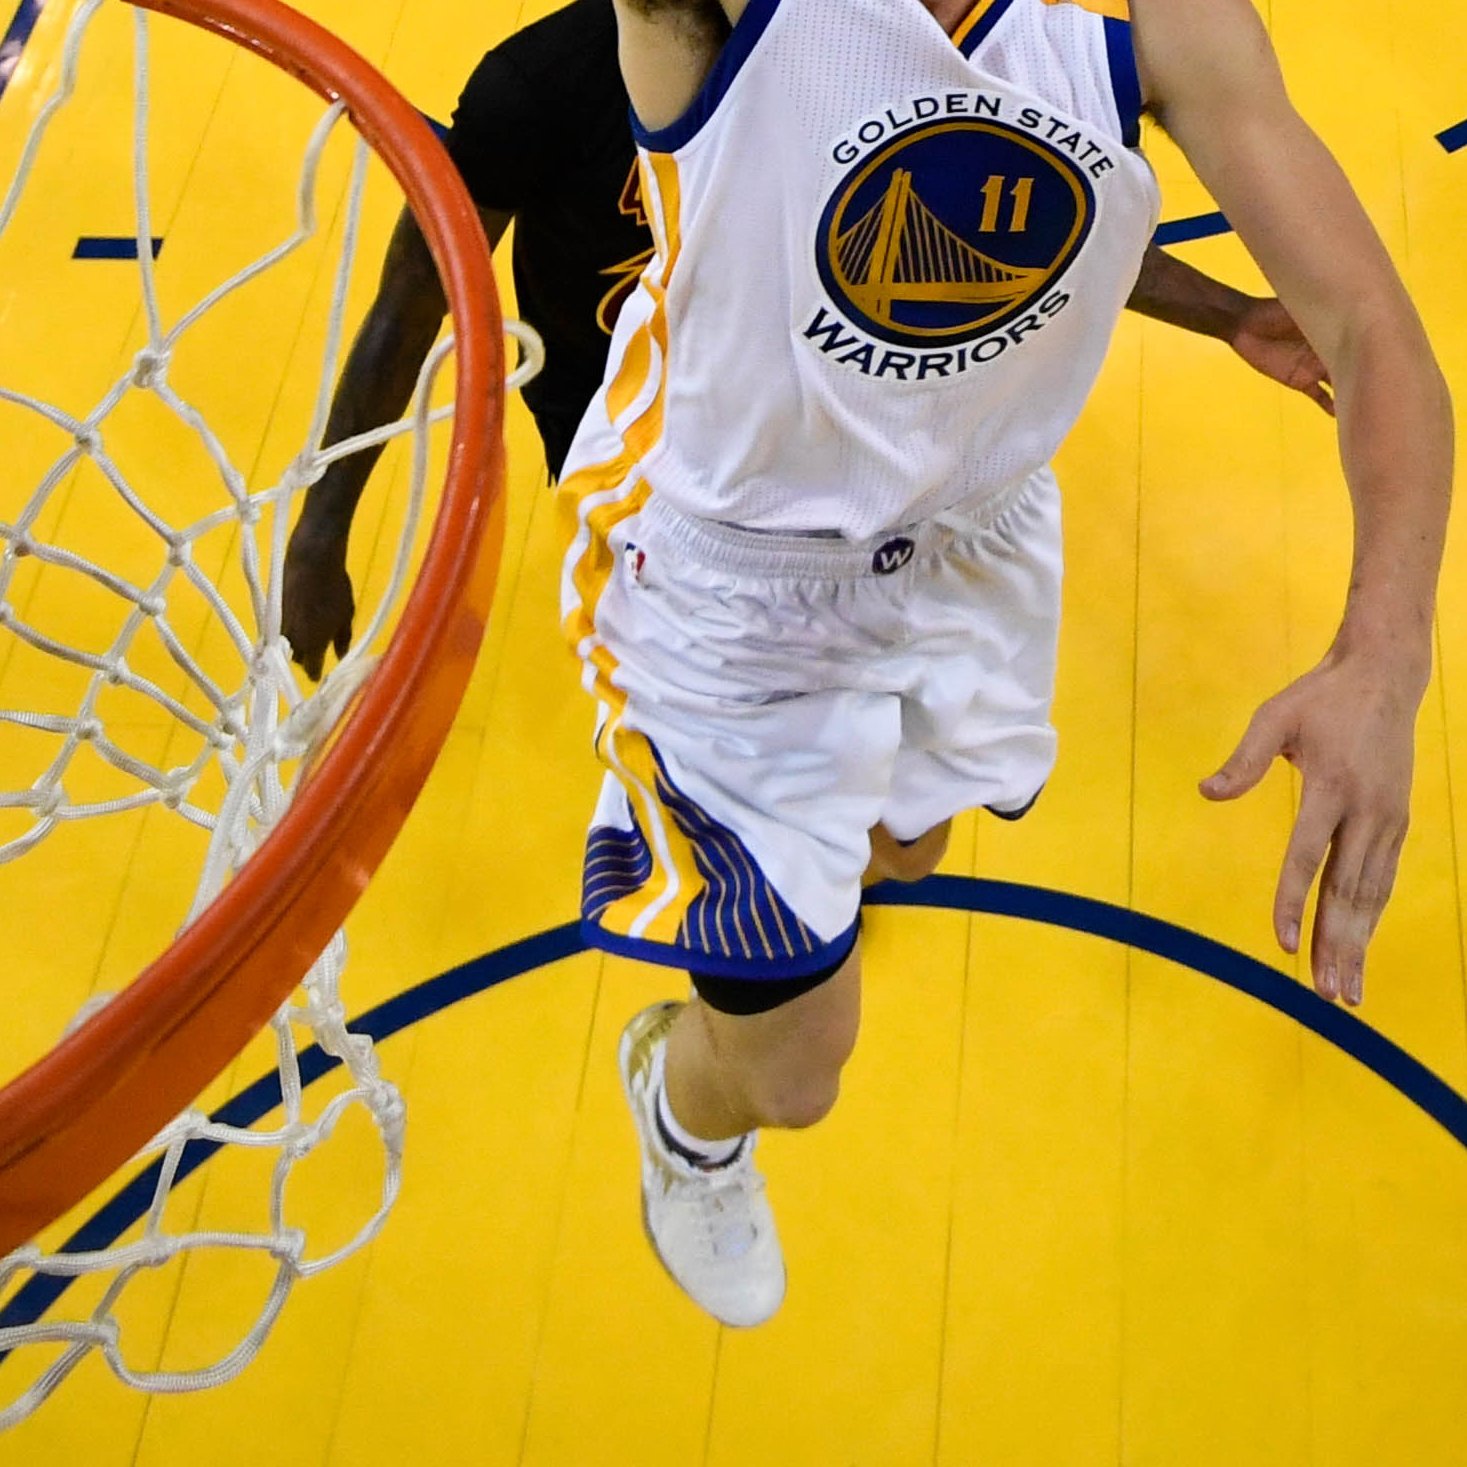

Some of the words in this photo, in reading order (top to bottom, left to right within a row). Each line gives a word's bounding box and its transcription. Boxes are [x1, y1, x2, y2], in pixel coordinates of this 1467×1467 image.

[832, 93, 1002, 165] GOLDEN
[1017, 108, 1114, 179] STATE
[978, 174, 1035, 233] 11
[802, 288, 1073, 381] WARRIORS
